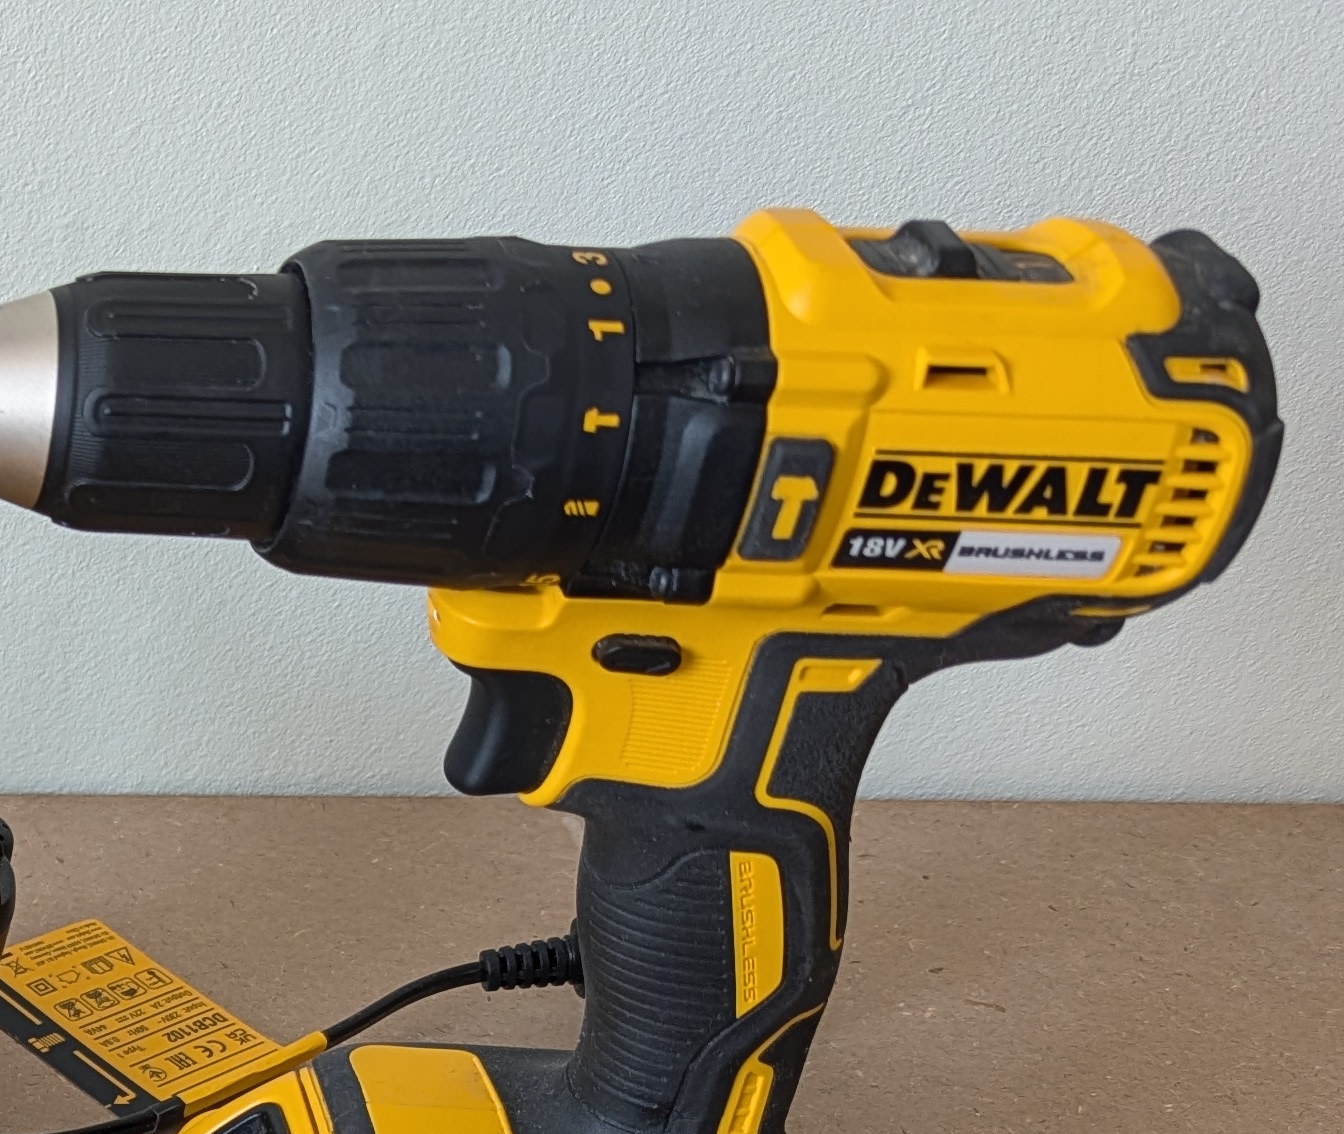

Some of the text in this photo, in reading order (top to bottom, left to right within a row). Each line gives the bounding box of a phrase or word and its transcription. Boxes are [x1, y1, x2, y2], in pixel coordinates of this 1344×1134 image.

[857, 460, 1161, 519] DEWALT
[848, 537, 1105, 562] 18V XR BRUSHLESS
[739, 861, 757, 1002] BRUSHLESS
[162, 1012, 229, 1043] DCB1102
